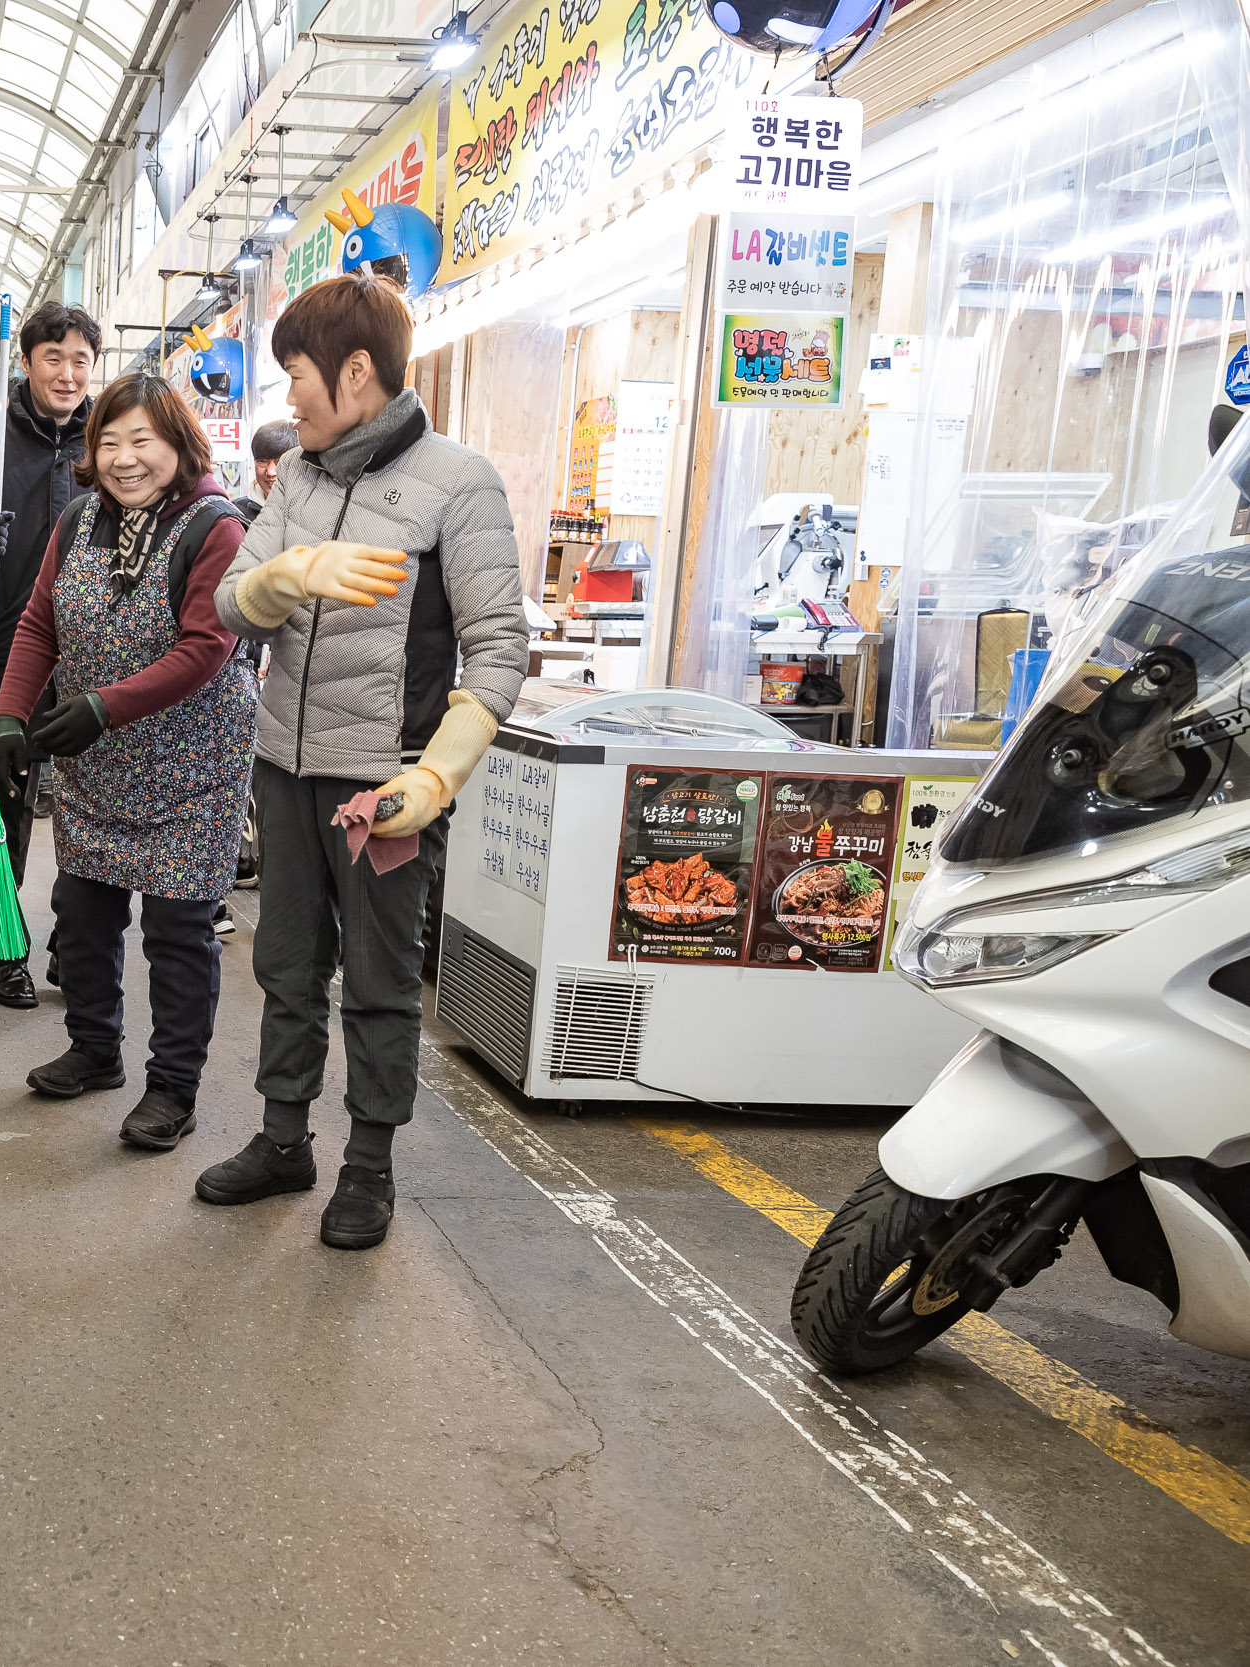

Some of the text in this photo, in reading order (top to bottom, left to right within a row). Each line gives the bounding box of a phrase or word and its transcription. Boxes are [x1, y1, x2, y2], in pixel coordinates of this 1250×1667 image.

[746, 100, 779, 113] 110호
[752, 116, 843, 151] 행복한
[736, 154, 852, 191] 고기마을
[727, 279, 822, 297] 주문 예약 받습니다
[735, 355, 832, 384] 선물세트
[782, 388, 830, 399] 판매합니다
[207, 420, 240, 450] 떡
[1171, 712, 1244, 743] HARDY
[484, 785, 514, 814] 한우사골
[517, 795, 550, 828] 한우사골
[782, 803, 798, 812] 맛있는
[643, 804, 742, 825] 남춘천 닭갈비
[482, 816, 512, 845] 한우우족
[515, 828, 548, 861] 한우우족
[483, 848, 505, 876] 우삼겹
[516, 862, 540, 892] 우삼겹
